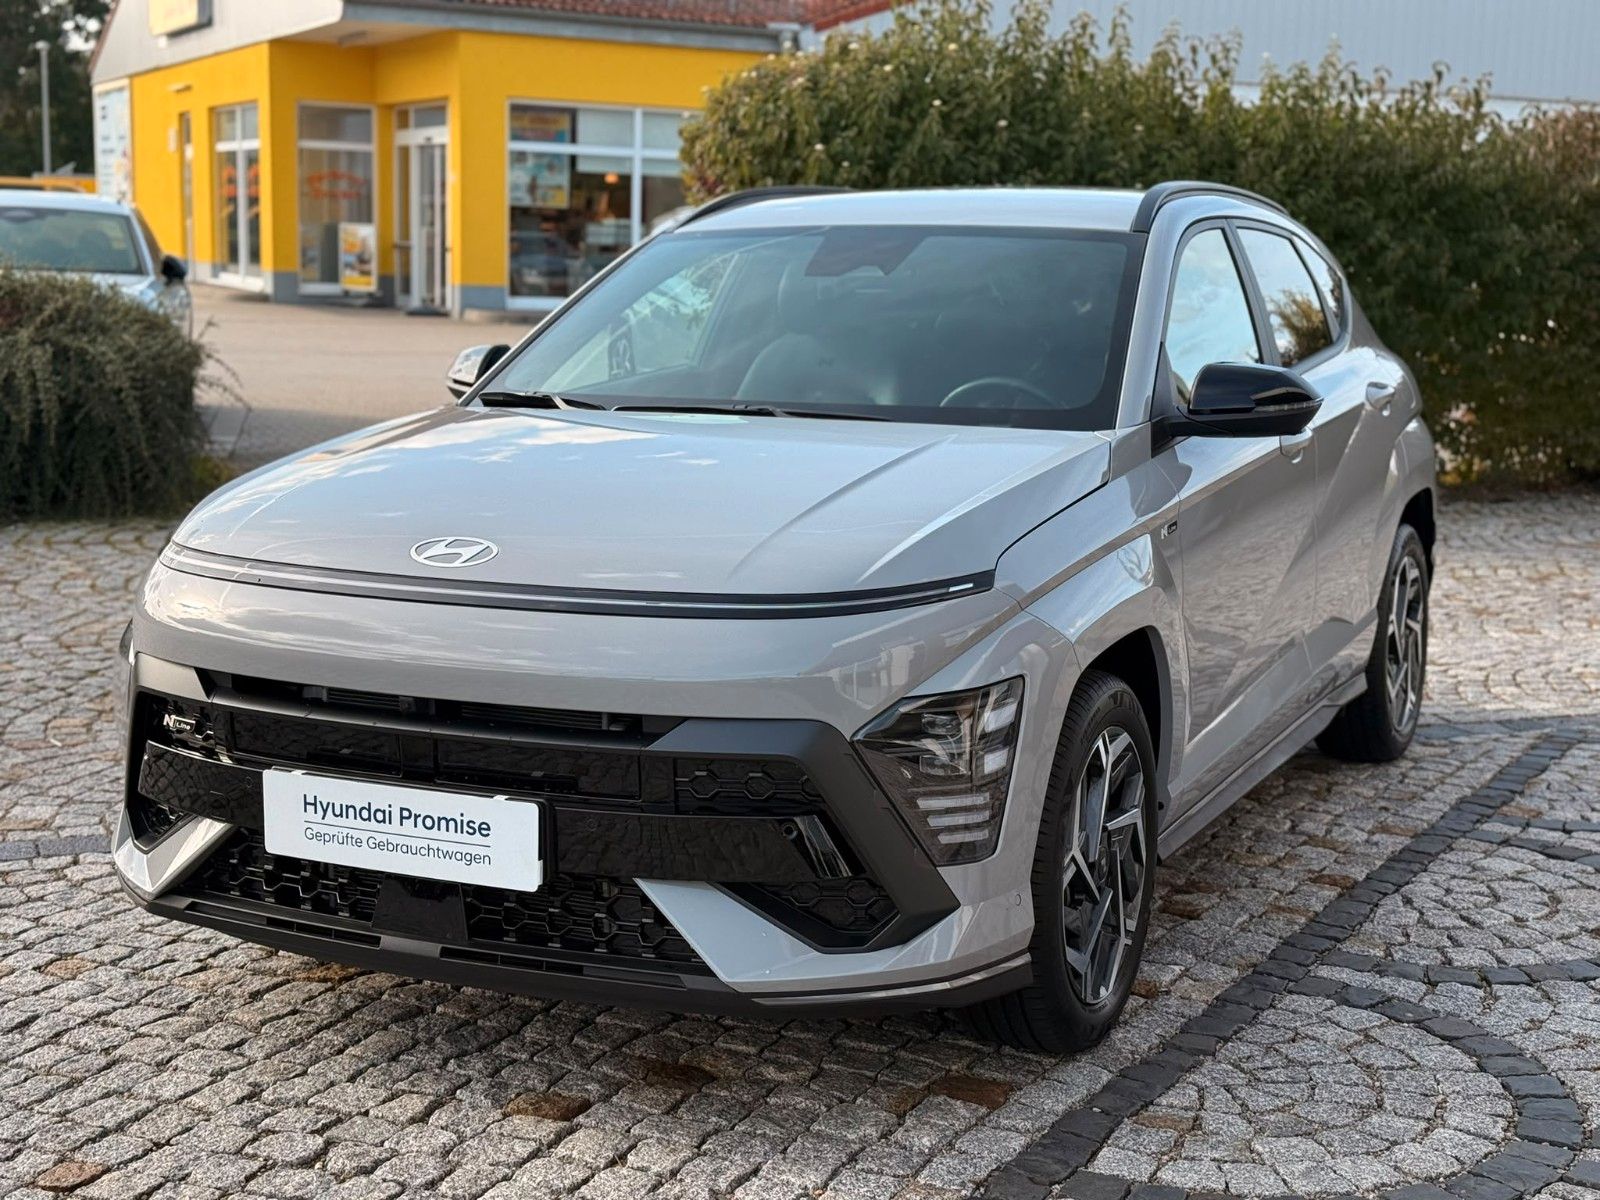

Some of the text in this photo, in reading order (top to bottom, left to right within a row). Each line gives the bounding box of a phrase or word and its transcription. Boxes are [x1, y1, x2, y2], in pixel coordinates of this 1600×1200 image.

[163, 714, 191, 730] N Line
[303, 794, 491, 837] Hyundai Promise
[304, 827, 491, 866] Geprüfte Gebrauchtwagen
